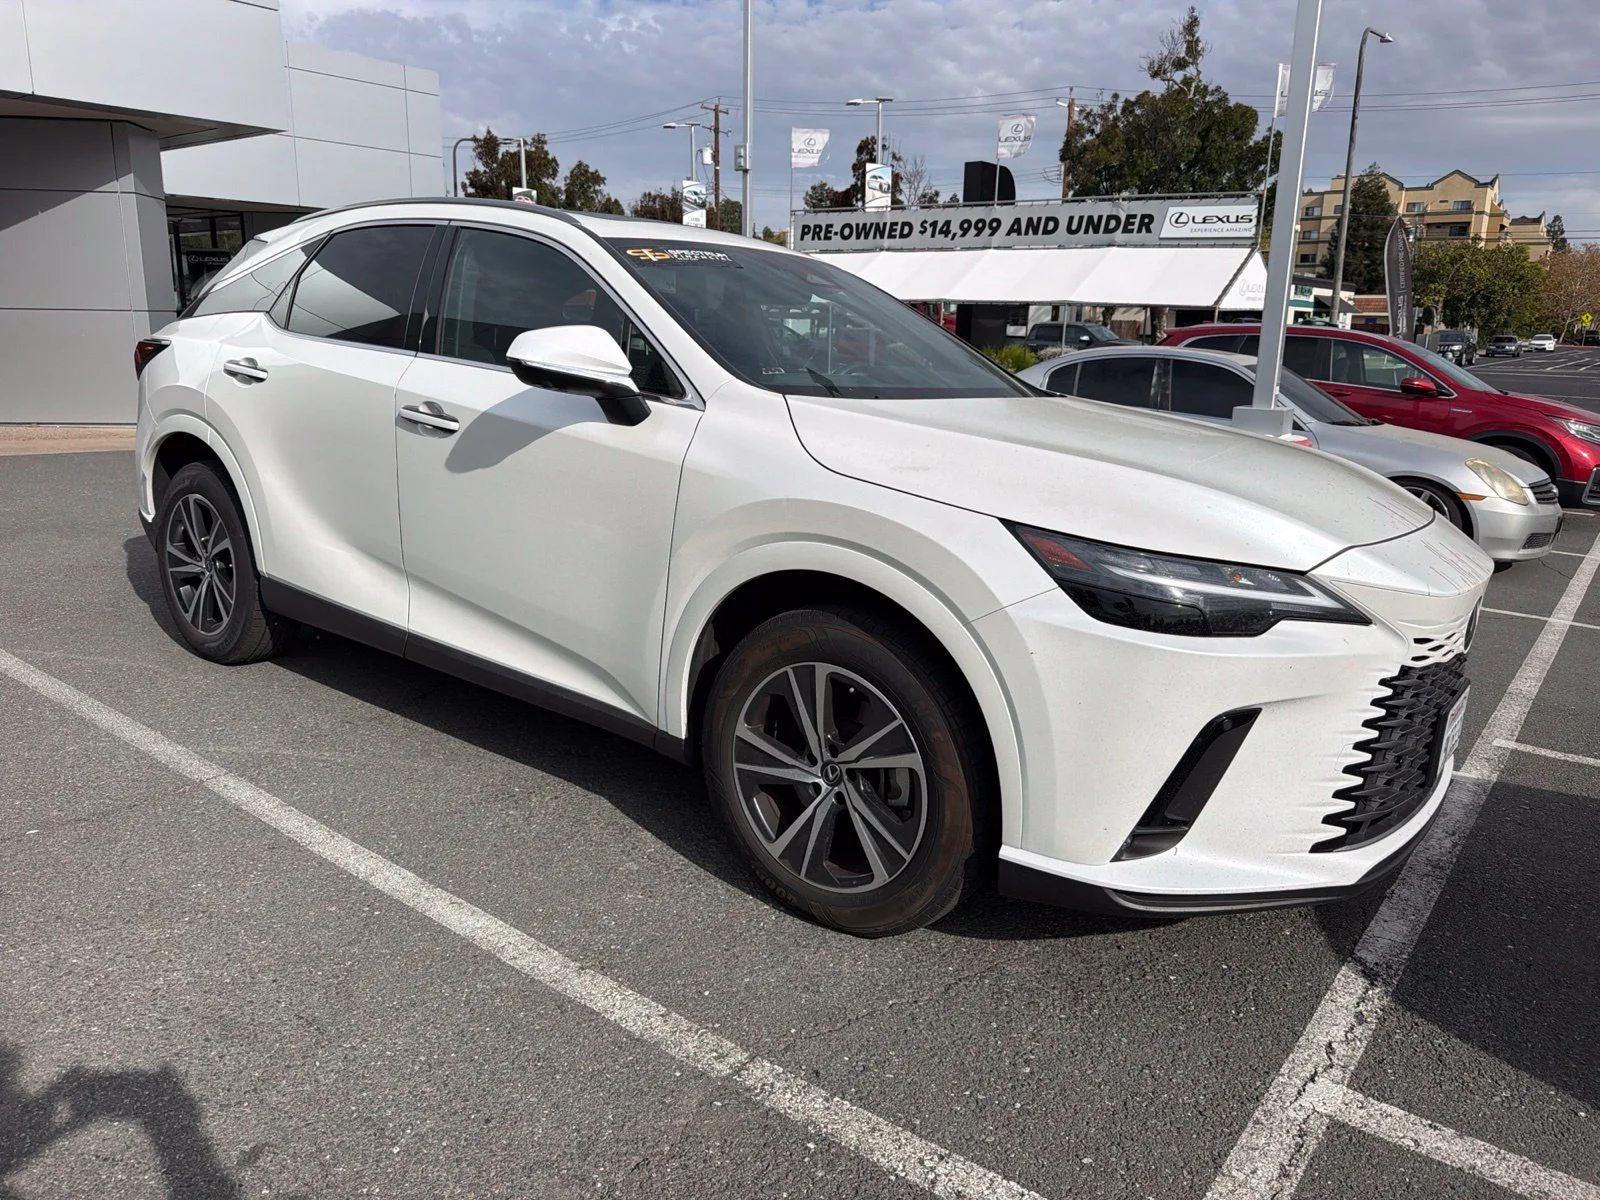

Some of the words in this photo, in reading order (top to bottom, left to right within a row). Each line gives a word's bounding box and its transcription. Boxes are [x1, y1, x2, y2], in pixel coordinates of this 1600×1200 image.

[998, 135, 1031, 143] LEXUS
[1192, 214, 1253, 225] LEXUS
[799, 221, 914, 241] PRE-OWNED
[918, 216, 1002, 241] $14,999
[1005, 215, 1060, 236] AND
[1066, 213, 1155, 236] UNDER
